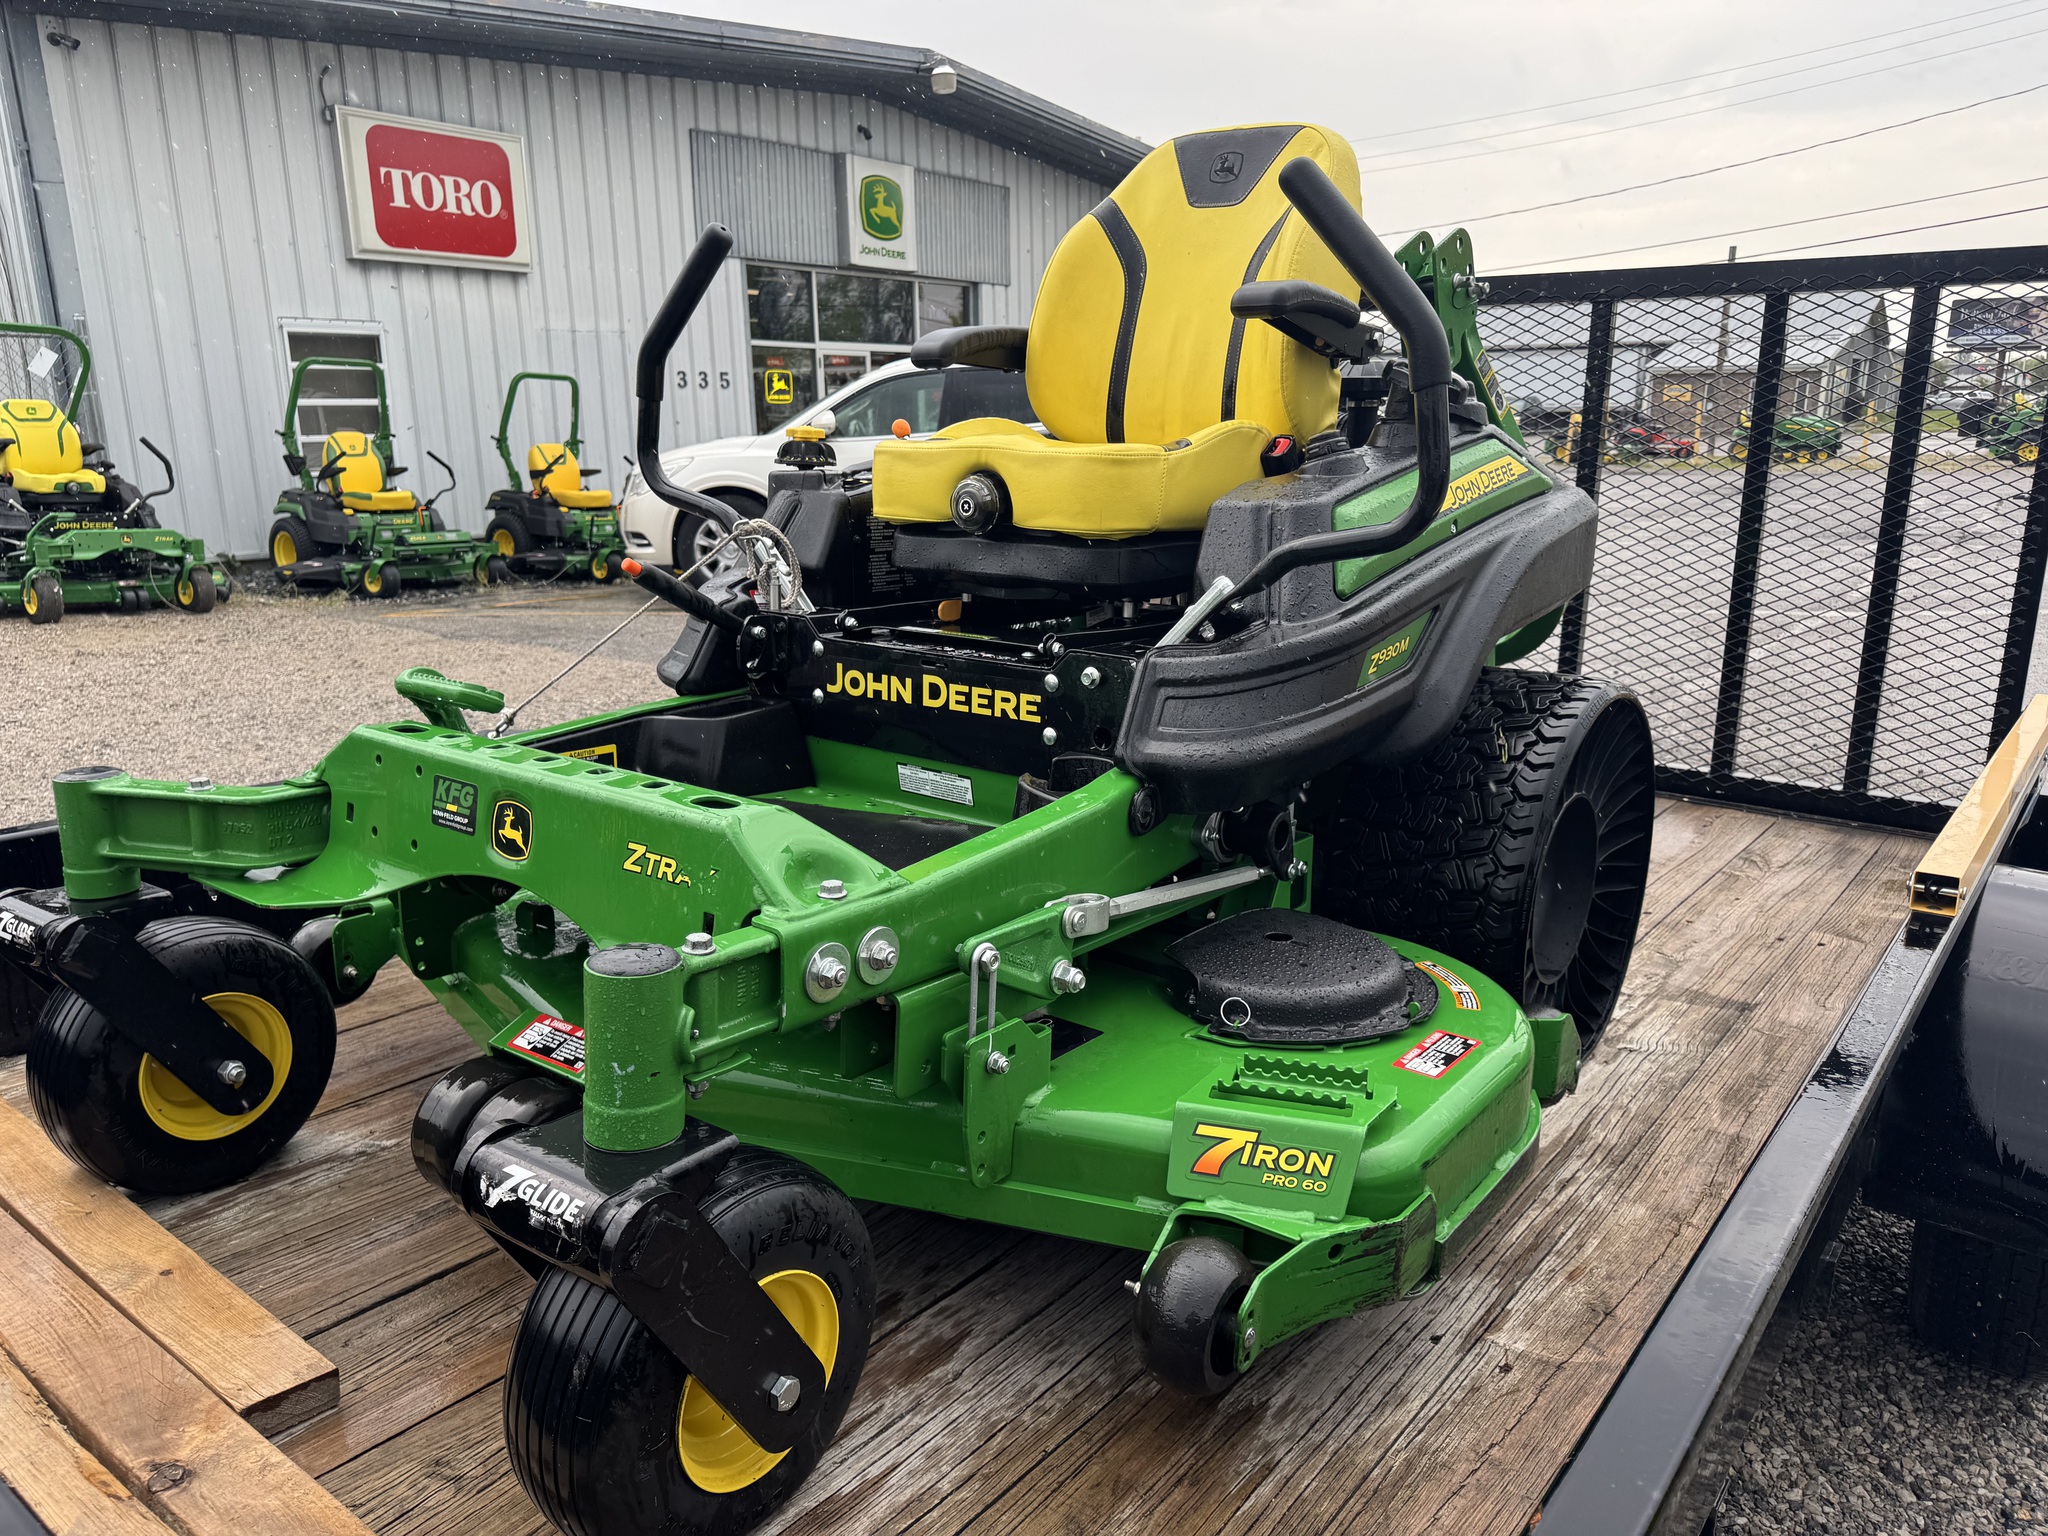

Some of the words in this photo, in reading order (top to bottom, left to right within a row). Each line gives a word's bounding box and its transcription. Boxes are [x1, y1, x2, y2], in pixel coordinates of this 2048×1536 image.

[380, 166, 502, 218] TORO
[859, 244, 880, 256] JOHN
[881, 246, 906, 260] DEERE
[1449, 484, 1482, 507] JOHN
[1478, 462, 1517, 490] DEERE
[54, 521, 80, 530] JOHN
[82, 521, 115, 529] DEERE
[1367, 635, 1410, 675] Z930M
[826, 662, 912, 704] JOHN
[922, 674, 1042, 723] DEERE
[573, 749, 596, 758] CAUTION
[435, 778, 475, 808] KFG
[550, 1019, 573, 1032] DANGER
[1261, 1172, 1299, 1189] PRO
[1302, 1179, 1328, 1193] 60
